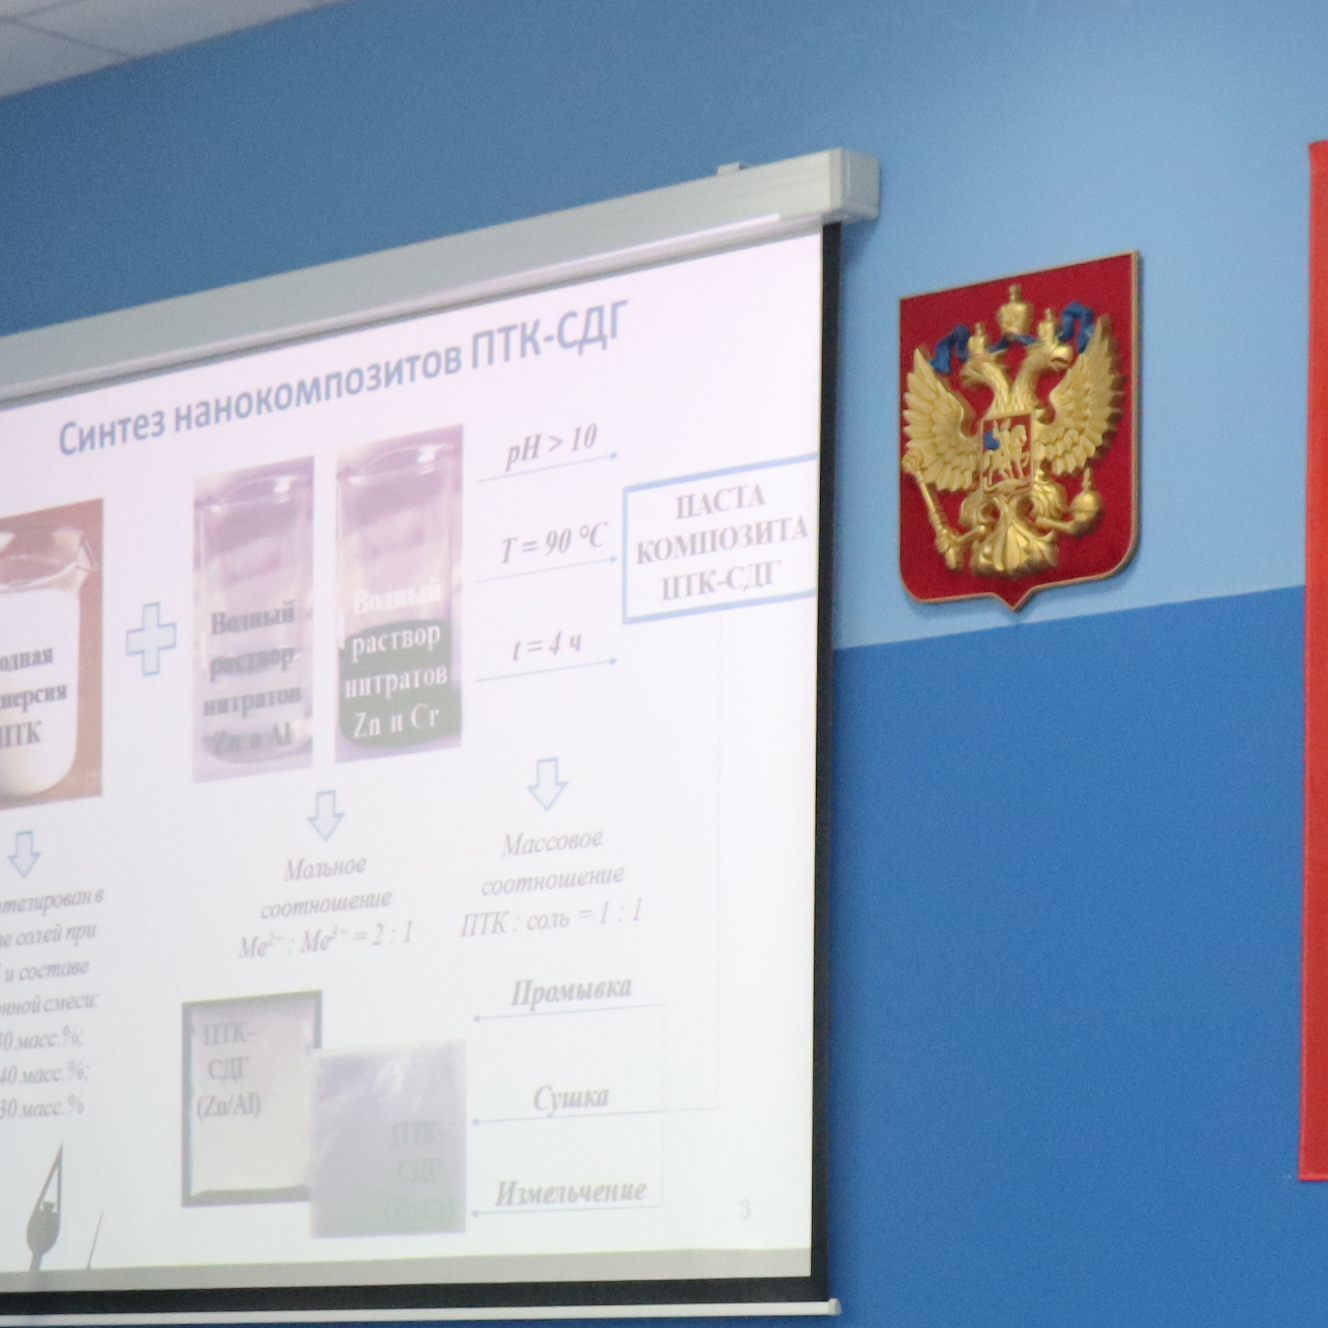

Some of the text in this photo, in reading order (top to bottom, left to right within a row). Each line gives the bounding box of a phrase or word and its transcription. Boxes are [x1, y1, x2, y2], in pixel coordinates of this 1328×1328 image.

[59, 300, 629, 456] Синтез нанокомпозитов ПТК-СДГ
[505, 434, 542, 472] pH
[572, 423, 598, 451] 10
[675, 484, 766, 519] ПАСТА
[545, 528, 572, 556] 90
[636, 516, 808, 565] КОМПОЗИТА
[662, 560, 782, 600] ПТК-СДГ
[211, 600, 295, 635] Водный
[352, 624, 441, 663] раствор
[549, 630, 563, 656] 4
[345, 666, 448, 699] нитратов
[203, 687, 302, 718] нитратов
[354, 704, 439, 738] Zn и Cr
[501, 831, 603, 857] Массовое
[284, 857, 367, 882] Мольное
[481, 867, 625, 896] соотношение
[261, 891, 392, 919] соотношение
[16, 923, 62, 946] солей
[66, 924, 97, 947] при
[460, 910, 510, 937] ПТК
[527, 913, 570, 930] соль
[19, 961, 90, 981] составе
[511, 978, 633, 1011] Промывка
[202, 1021, 256, 1046] ПТК-
[208, 1057, 250, 1083] СДГ
[196, 1092, 261, 1121] (Zn/Al)
[533, 1084, 610, 1118] Сушка
[495, 1180, 647, 1207] Измельчение
